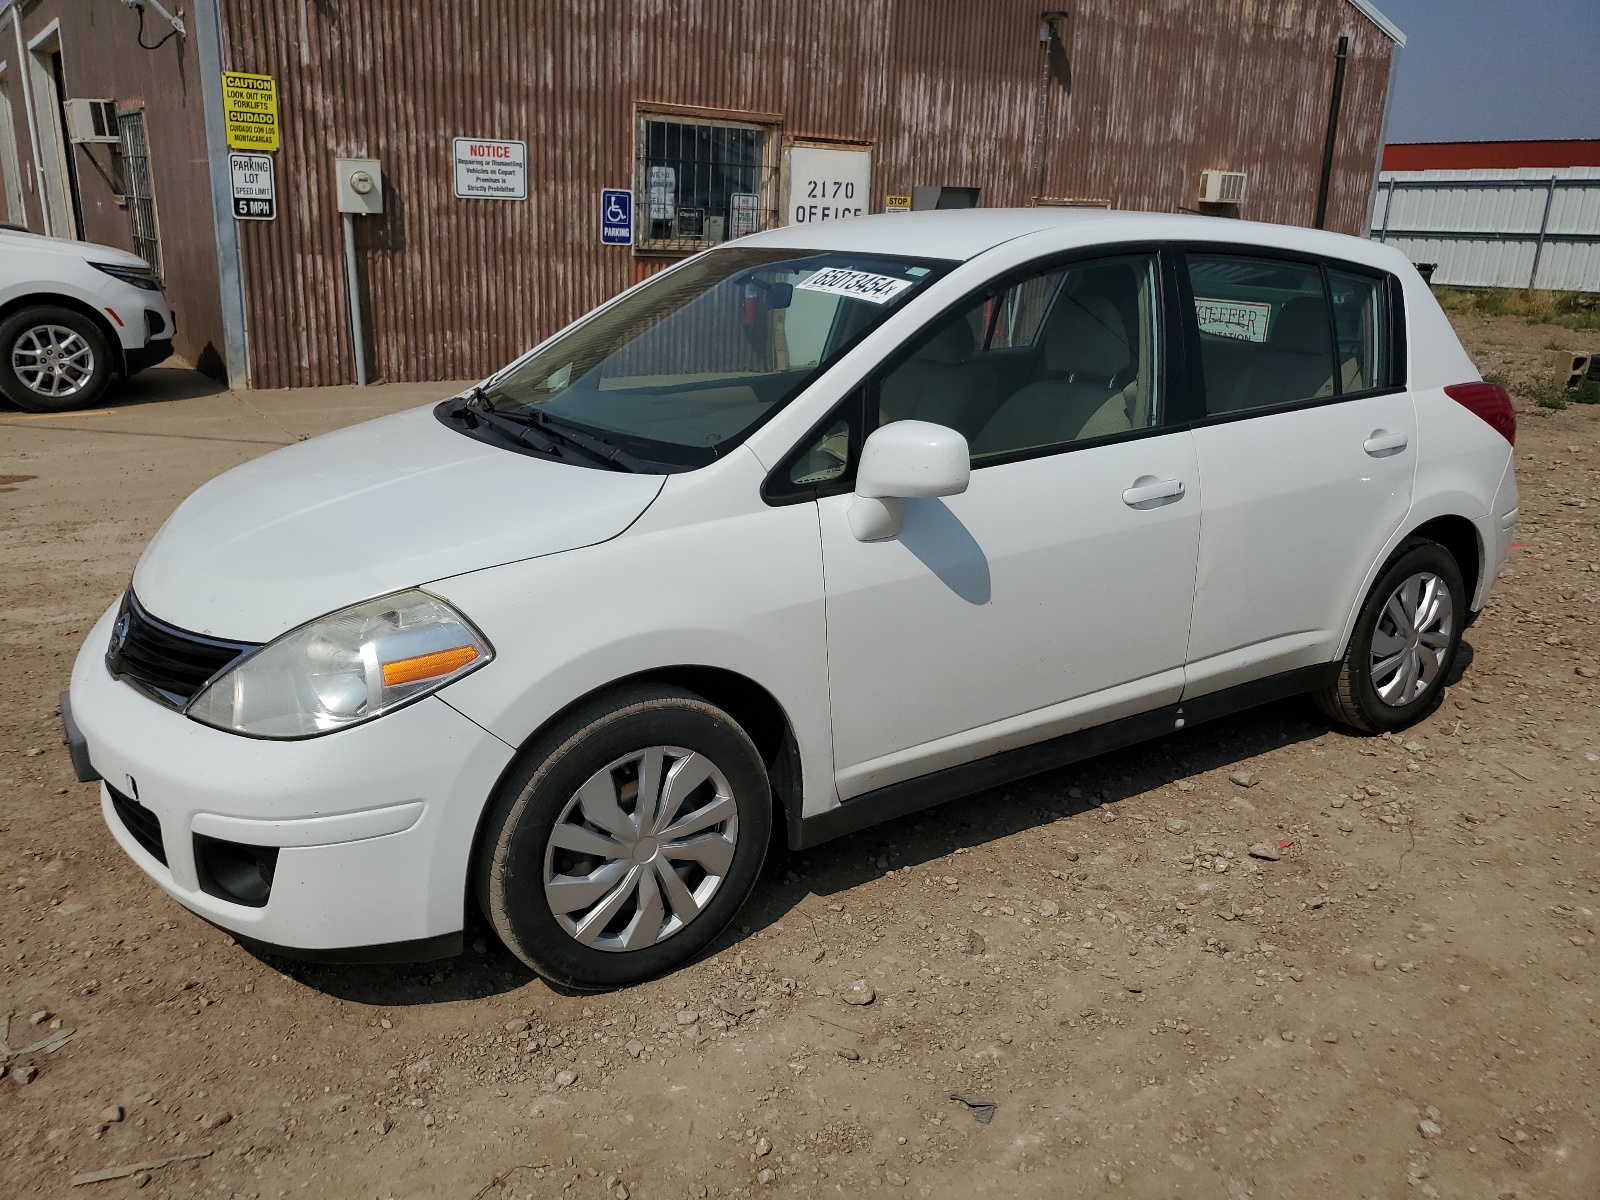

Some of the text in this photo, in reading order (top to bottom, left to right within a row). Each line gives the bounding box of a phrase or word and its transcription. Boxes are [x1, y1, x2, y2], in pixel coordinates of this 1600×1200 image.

[227, 77, 271, 90] CAUTION
[227, 90, 272, 102] LOOK OUT FOR
[234, 100, 268, 110] FORKLIFTS
[230, 111, 274, 124] CUIDADO
[230, 124, 275, 135] CUIDADO CON LOS
[234, 134, 272, 144] MONTACARGAS
[470, 144, 510, 158] NOTICE
[233, 160, 268, 172] PARKING
[458, 158, 484, 166] Repairing
[492, 160, 522, 168] Dismantling
[466, 167, 489, 175] Vehicles
[244, 173, 259, 184] LOT
[476, 176, 500, 184] Premises
[236, 186, 270, 196] SPEED LIMIT
[467, 184, 486, 193] Strictly
[808, 180, 854, 200] 2170
[888, 197, 907, 205] STOP
[239, 200, 270, 214] 5 MPH
[604, 227, 630, 238] PARKING
